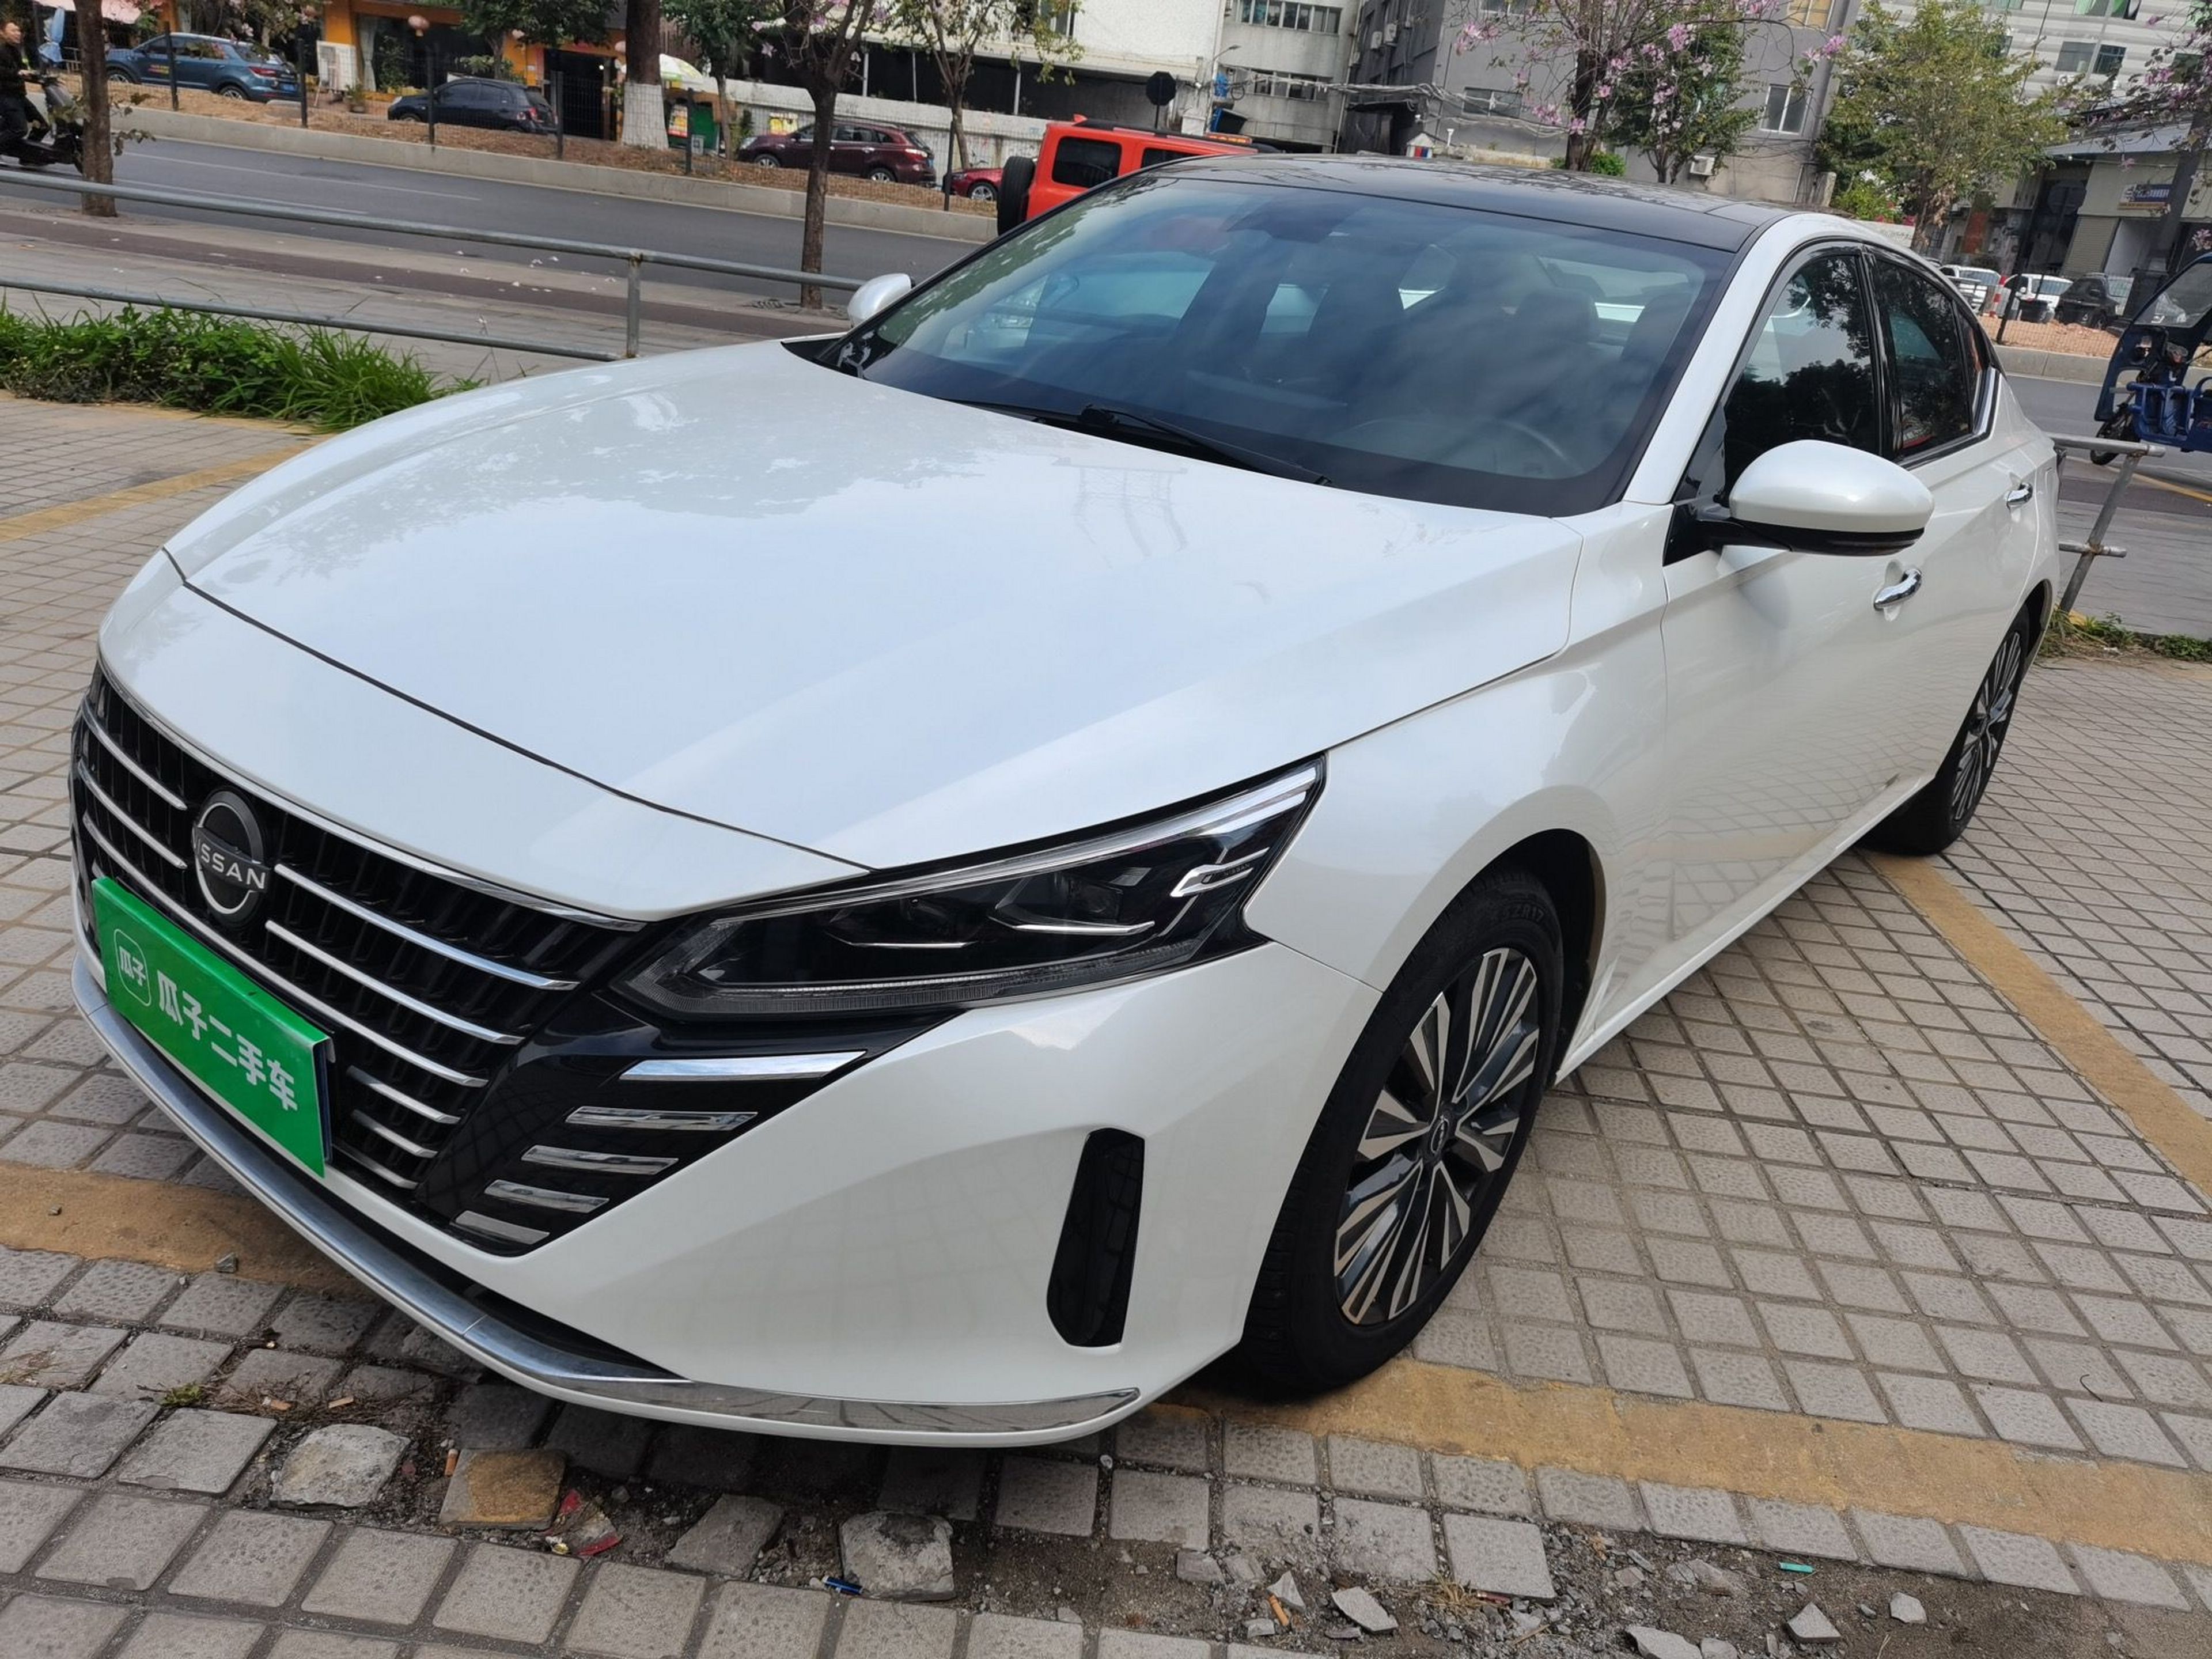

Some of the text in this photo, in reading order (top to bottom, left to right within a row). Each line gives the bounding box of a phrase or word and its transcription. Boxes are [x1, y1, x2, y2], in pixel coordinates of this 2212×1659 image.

[119, 945, 146, 987] 瓜子
[157, 969, 298, 1111] 瓜子二手车
